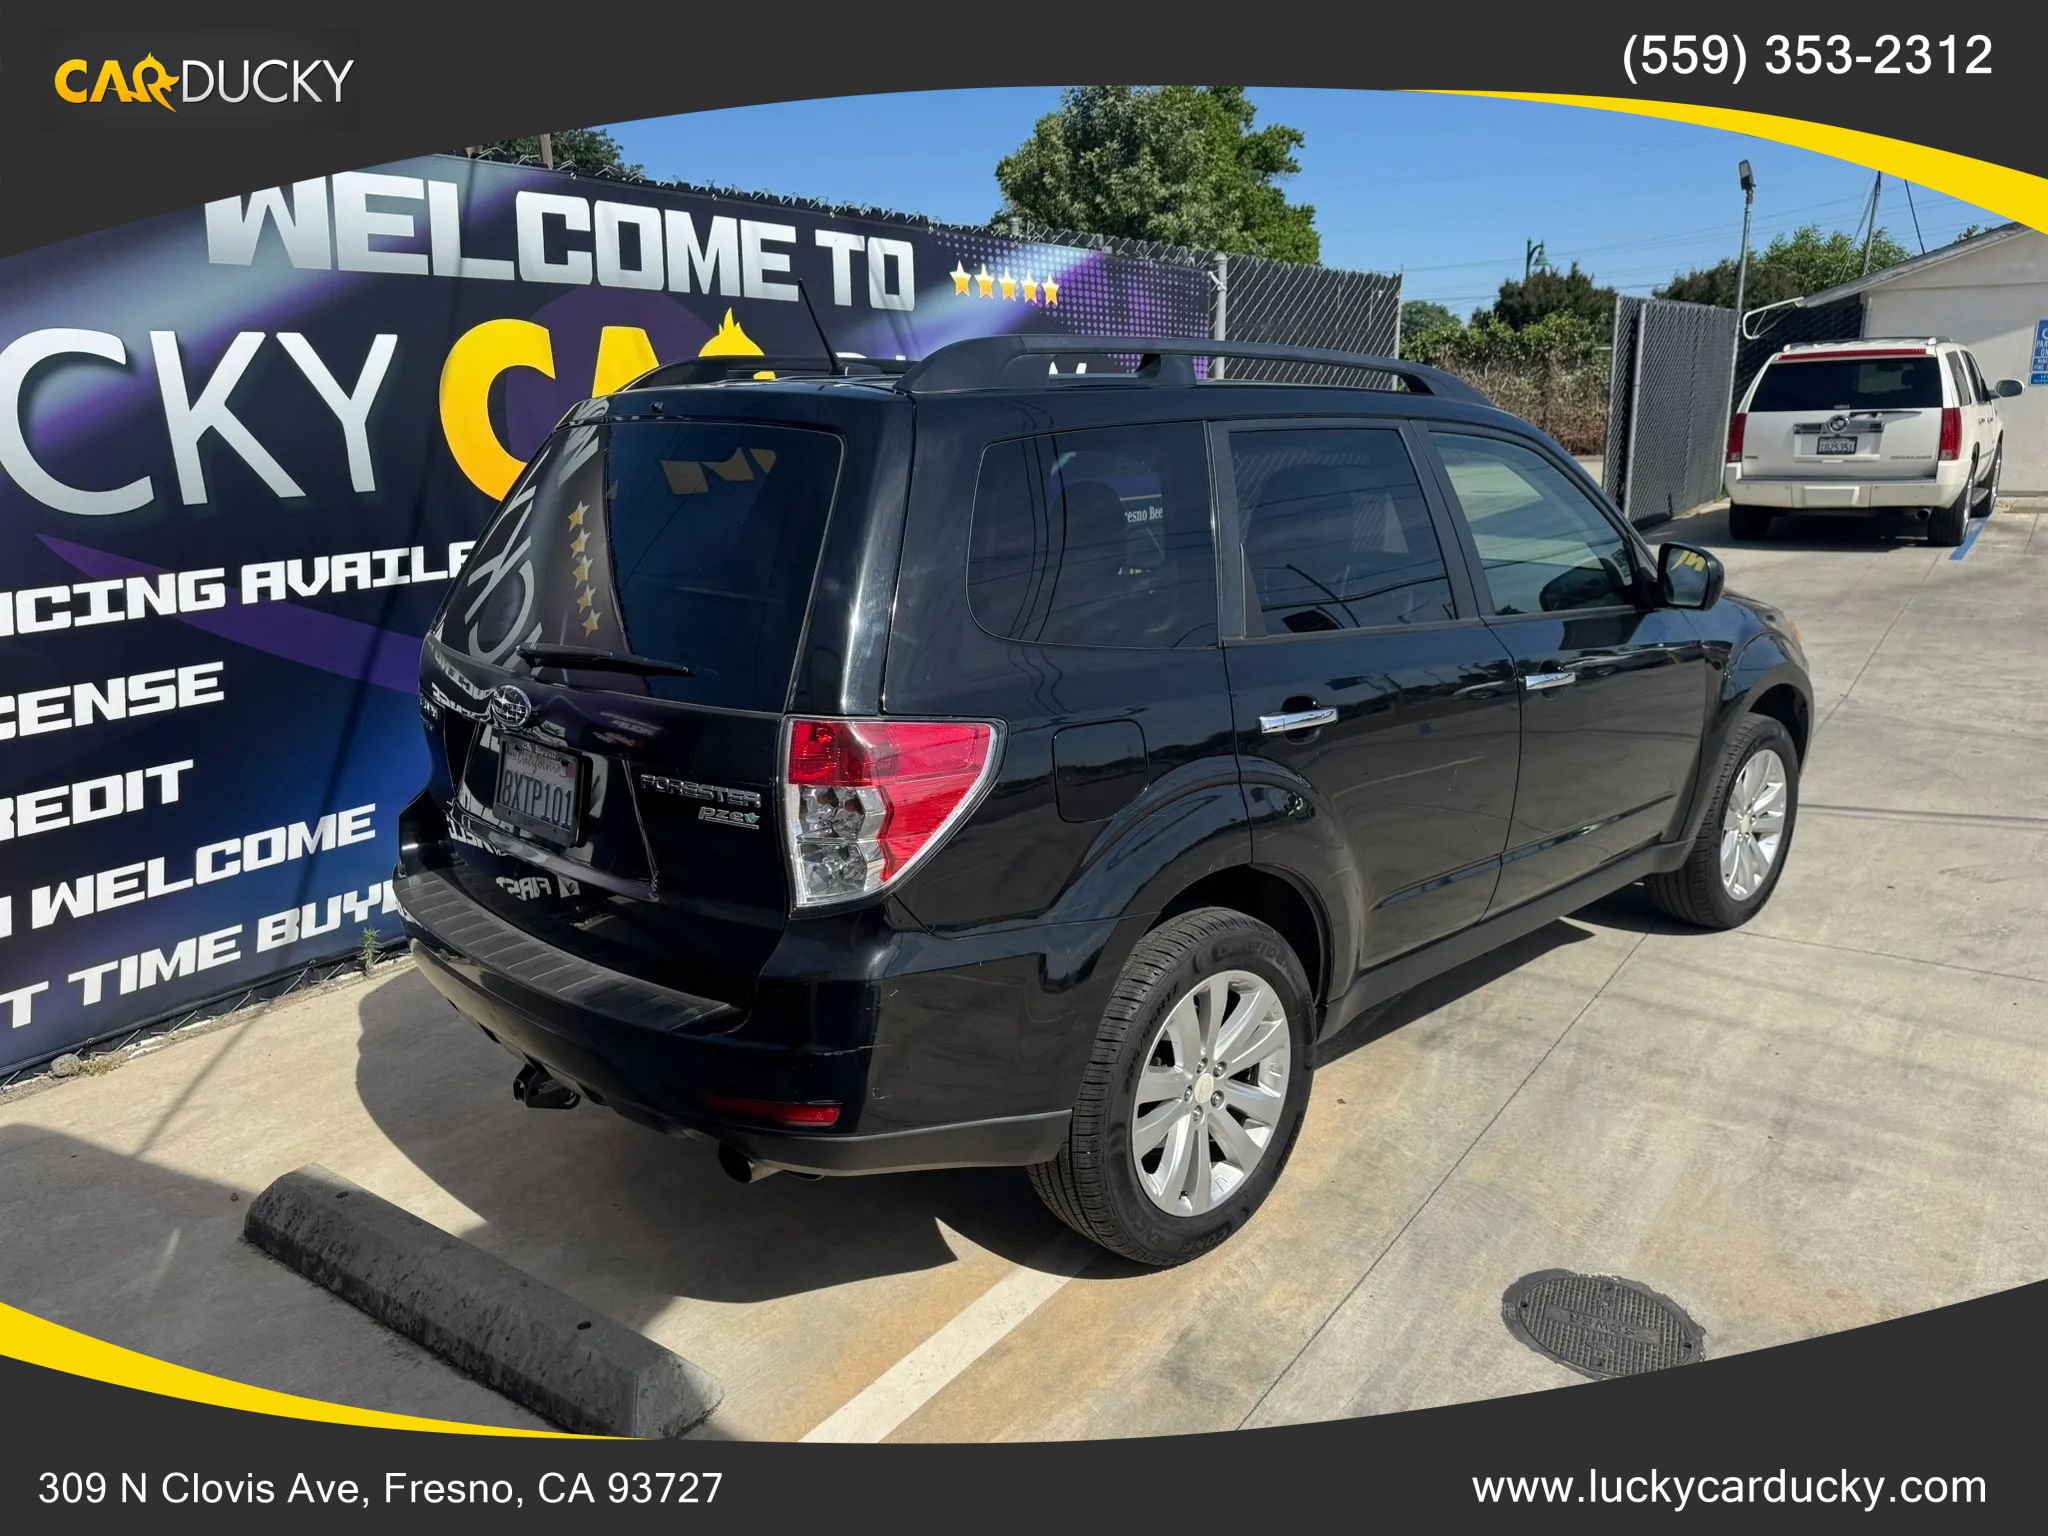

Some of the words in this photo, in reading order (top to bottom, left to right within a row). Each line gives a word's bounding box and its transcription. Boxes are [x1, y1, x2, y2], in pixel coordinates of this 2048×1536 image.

[205, 171, 799, 301] WELCOME
[815, 229, 915, 311] TO
[1149, 506, 1164, 519] Bee
[0, 568, 226, 636] CING
[0, 661, 225, 740] ENSE
[0, 759, 194, 841] EDIT
[501, 768, 573, 828] 8XTP101
[640, 774, 762, 808] FORESTER
[32, 803, 377, 929] WELCOME
[68, 924, 243, 1006] TIME
